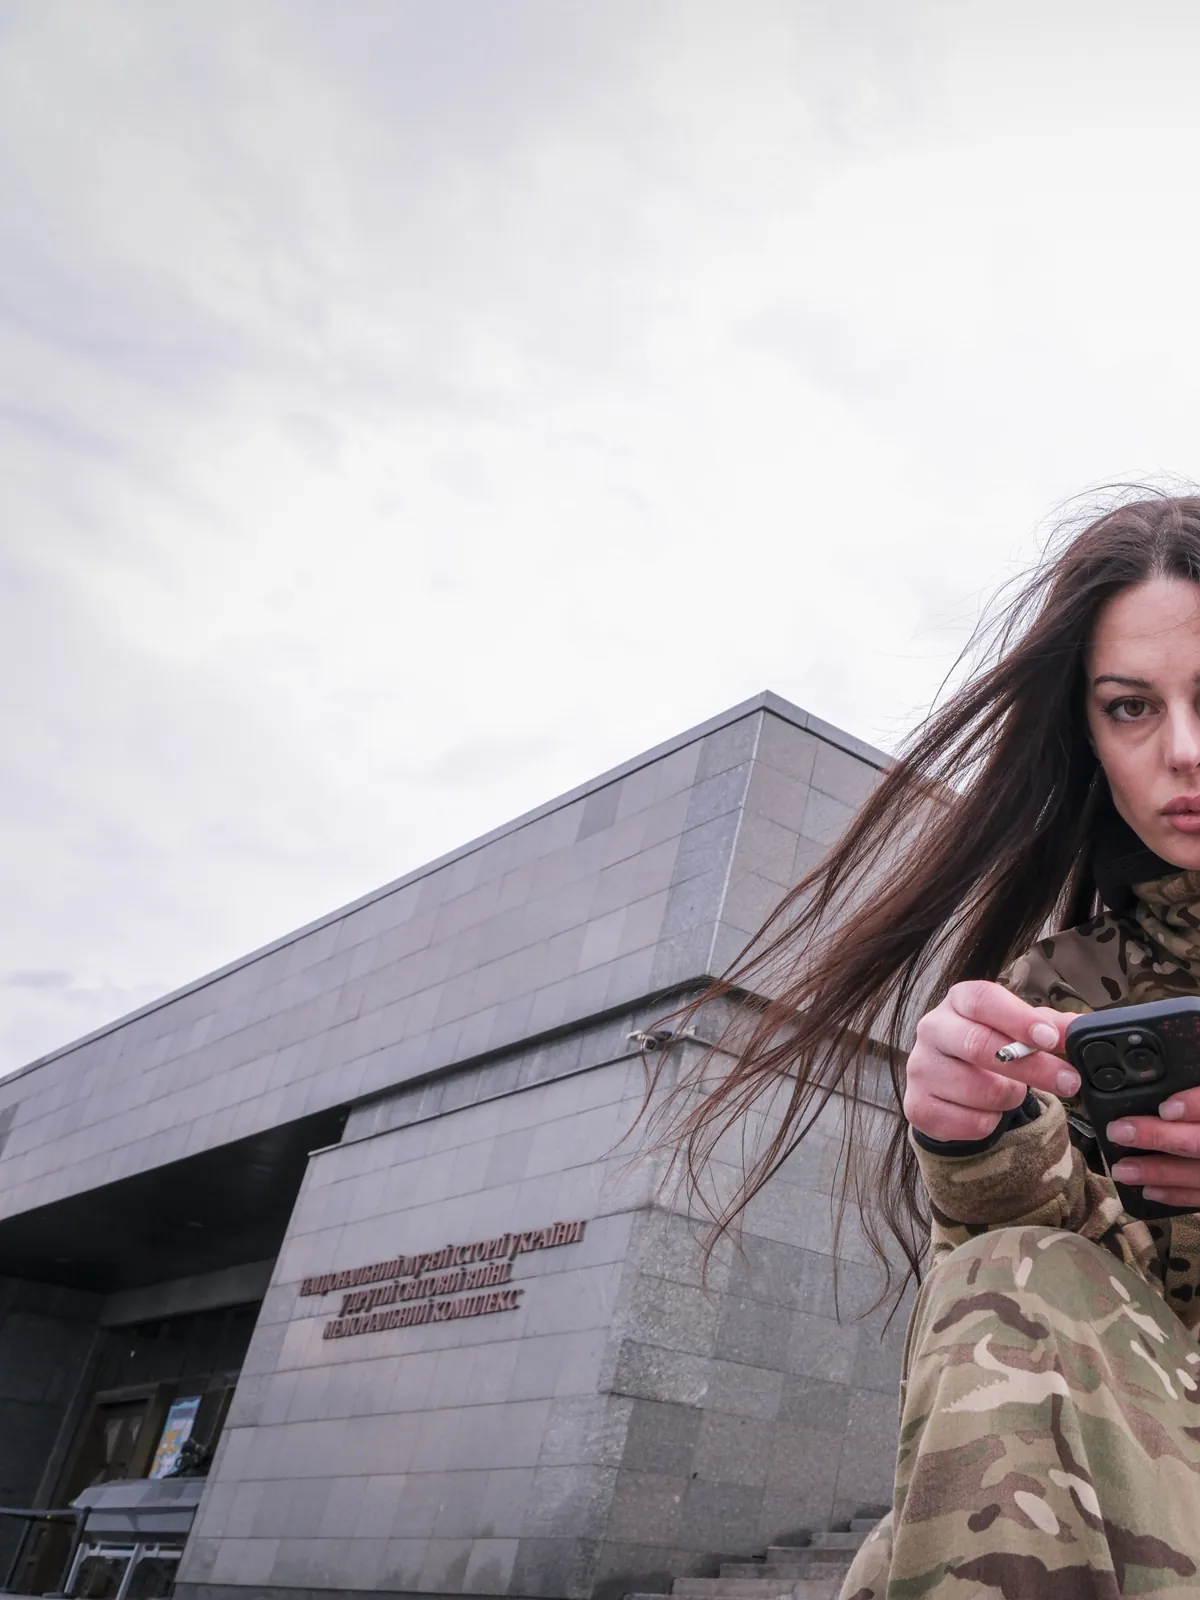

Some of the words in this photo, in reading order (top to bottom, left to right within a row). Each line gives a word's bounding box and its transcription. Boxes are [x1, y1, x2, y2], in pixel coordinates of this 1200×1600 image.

[401, 1245, 451, 1278] МУЗЕЙ
[451, 1234, 509, 1265] ІСТОРІЇ
[508, 1220, 585, 1261] УКРАЇНИ
[323, 1299, 431, 1339] МЕМОРІАЛЬНИЙ
